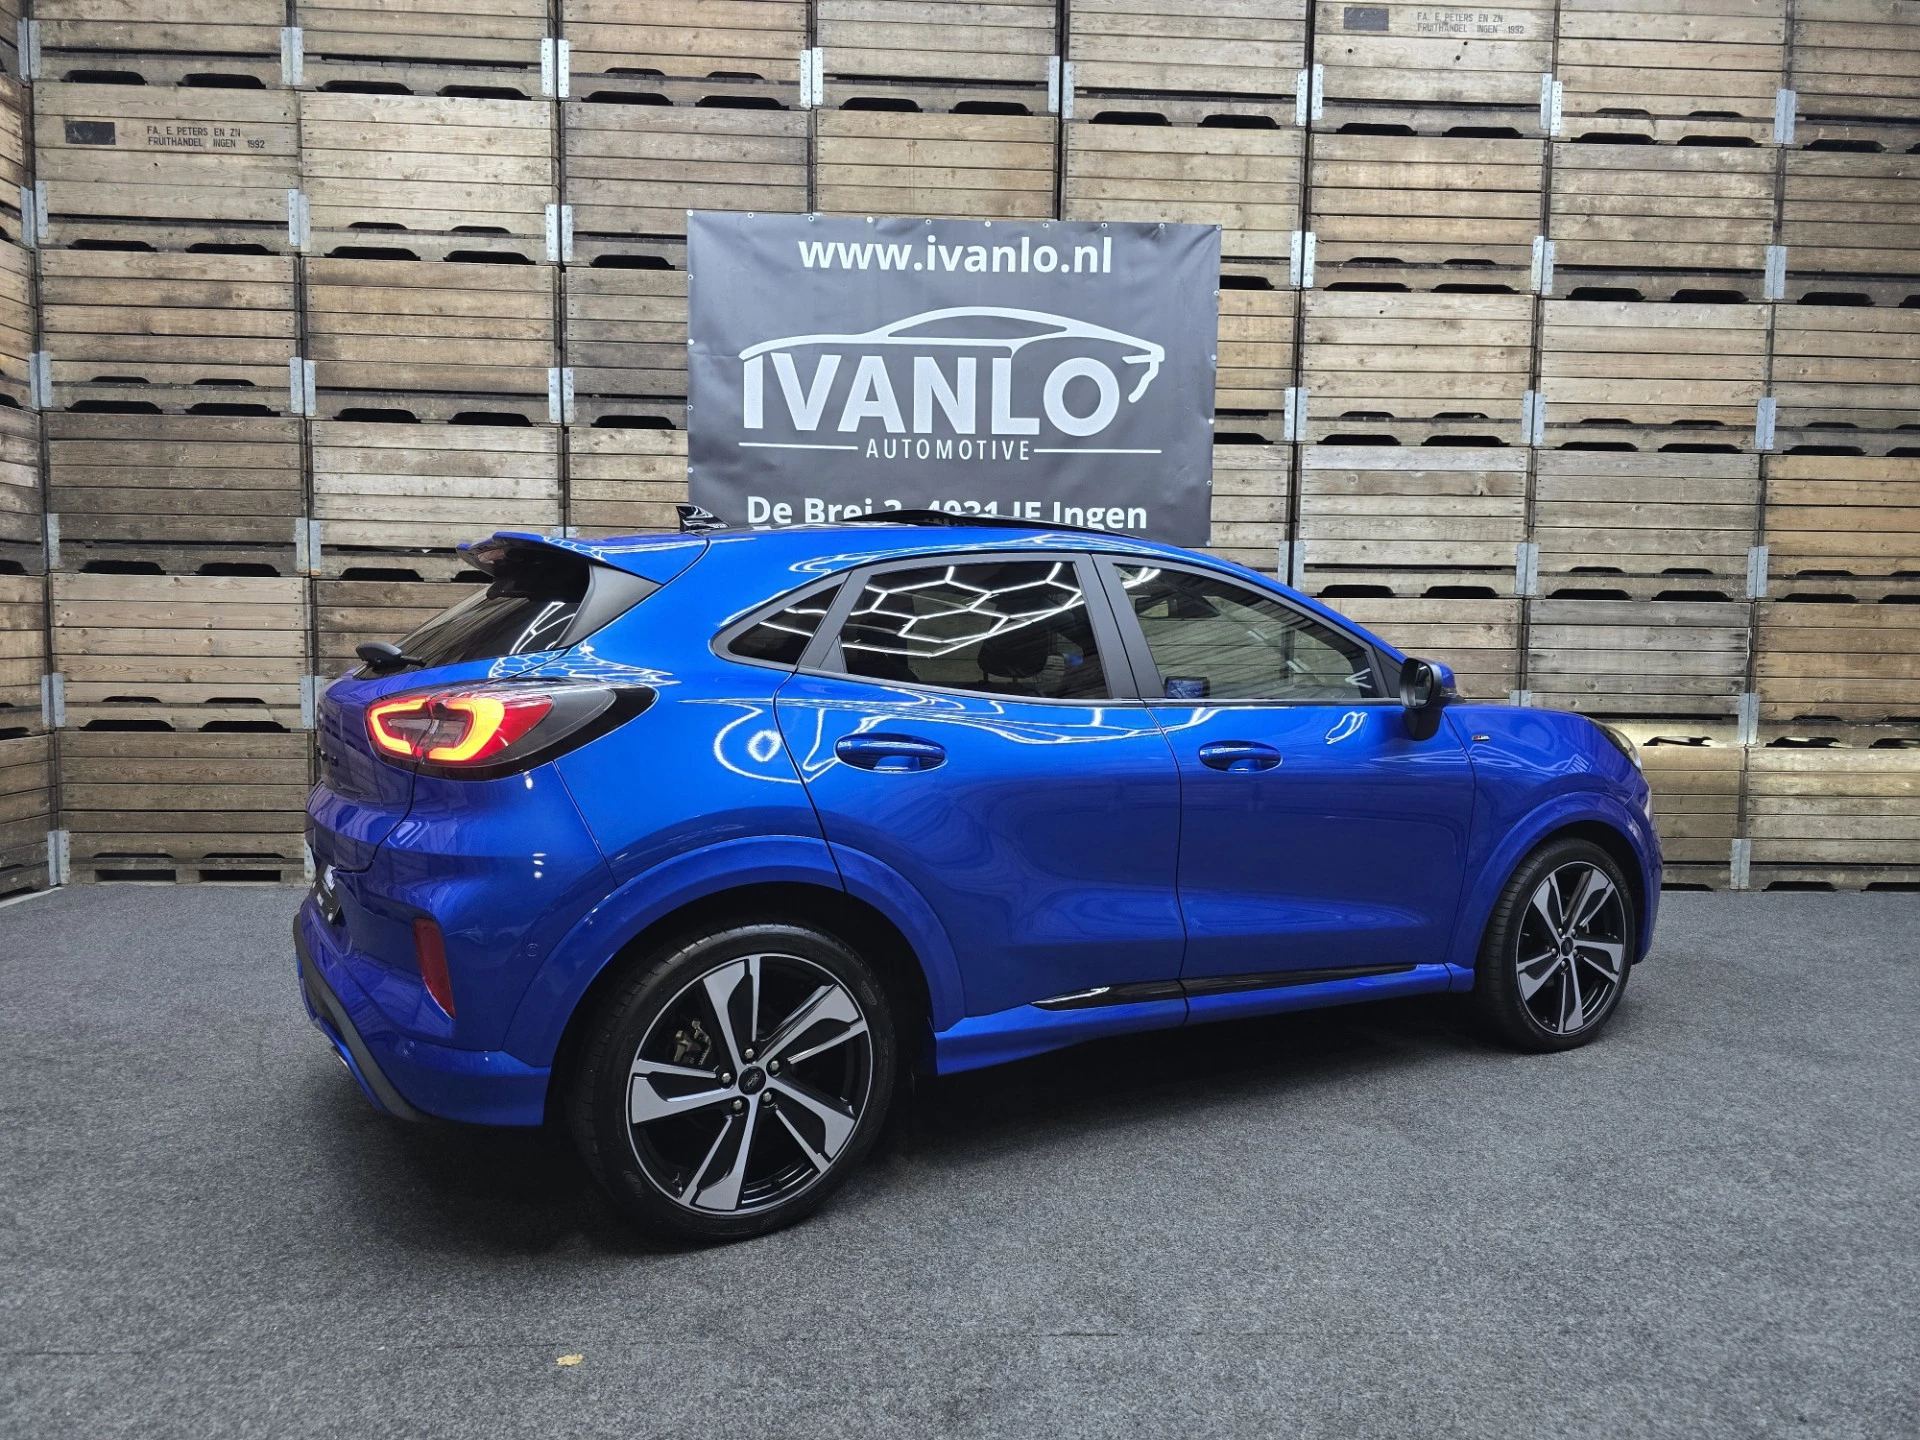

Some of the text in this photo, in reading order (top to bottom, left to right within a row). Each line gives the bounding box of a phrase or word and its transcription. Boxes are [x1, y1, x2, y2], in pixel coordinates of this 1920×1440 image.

[1444, 13, 1474, 23] PETERS
[1478, 13, 1489, 23] EN
[1417, 22, 1525, 35] FRUITHANDEL INGEN 1992
[177, 126, 208, 137] PETERS
[214, 127, 225, 137] EN
[229, 128, 241, 138] ZN
[148, 136, 265, 149] FRUITHANDEL INGEN 1992
[798, 235, 1112, 273] www.ivanlo.nl
[743, 353, 1120, 436] IVANLO
[866, 438, 1030, 461] AUTOMOTIVE
[747, 496, 792, 524] De
[1053, 501, 1147, 531] Ingen
